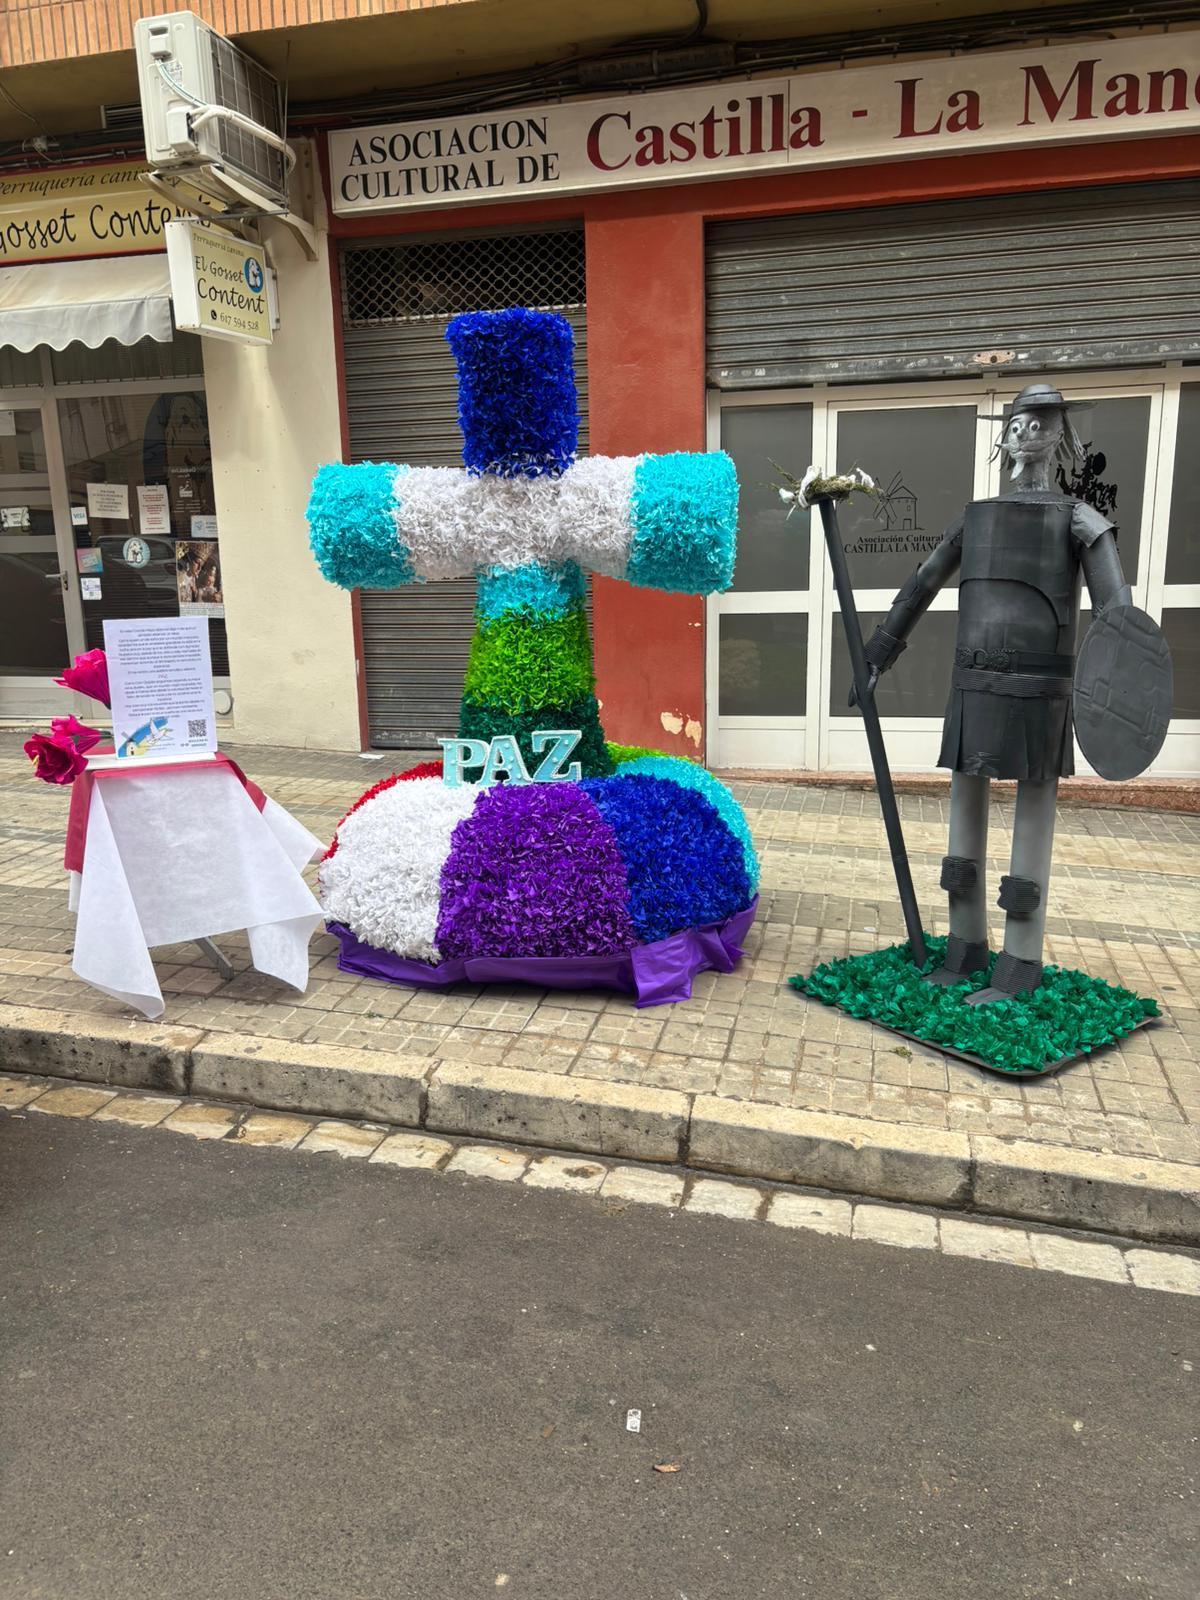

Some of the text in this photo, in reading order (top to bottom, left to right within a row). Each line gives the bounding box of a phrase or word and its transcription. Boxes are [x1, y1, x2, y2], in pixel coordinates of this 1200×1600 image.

[348, 116, 549, 167] ASOCIACION
[586, 93, 826, 171] Castilla
[852, 109, 868, 118] -
[893, 77, 985, 139] La
[100, 167, 150, 184] cani
[340, 152, 561, 202] CULTURAL DE
[89, 194, 211, 240] Conte
[194, 255, 245, 284] El Gosset
[197, 277, 265, 314] Content
[219, 312, 259, 331] 617 594 528
[844, 541, 941, 554] CASTILLA LA MANC
[857, 534, 944, 544] Asociación Cultural
[437, 729, 583, 788] PAZ
